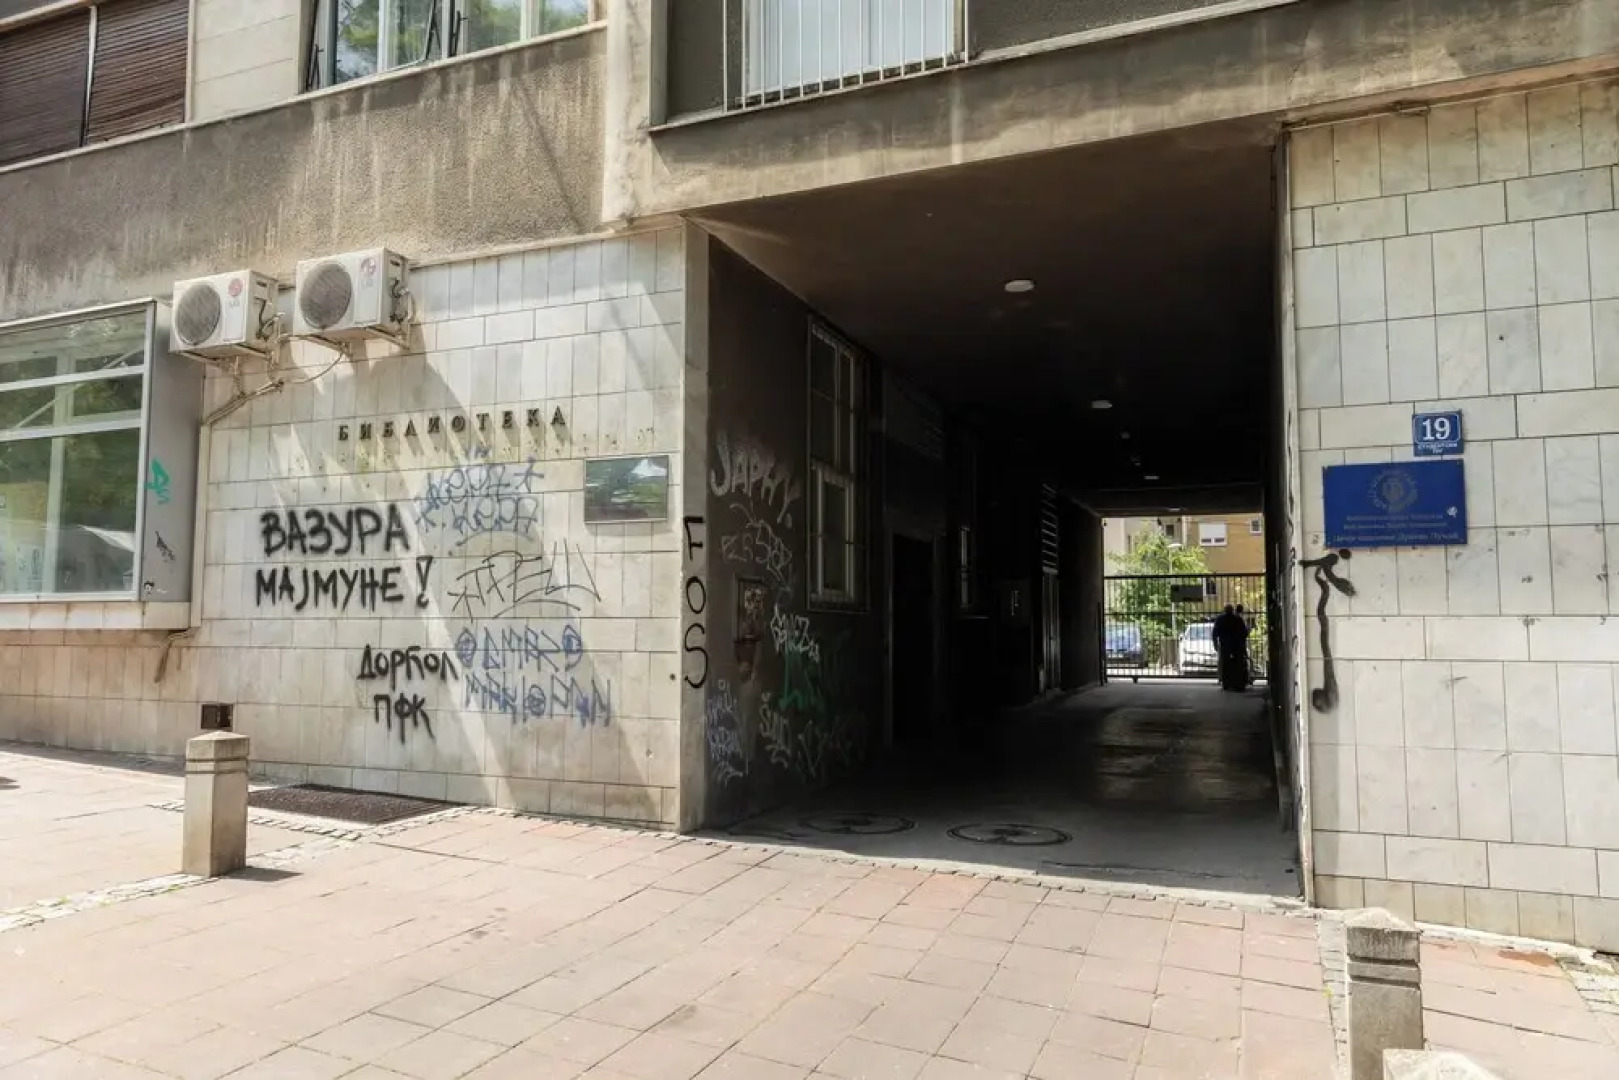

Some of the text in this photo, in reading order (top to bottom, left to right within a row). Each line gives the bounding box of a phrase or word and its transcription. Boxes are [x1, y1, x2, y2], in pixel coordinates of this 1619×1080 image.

[337, 405, 566, 442] БИБЛИОТЕКА
[1422, 417, 1451, 441] 19
[260, 503, 411, 557] ВАЗУРА
